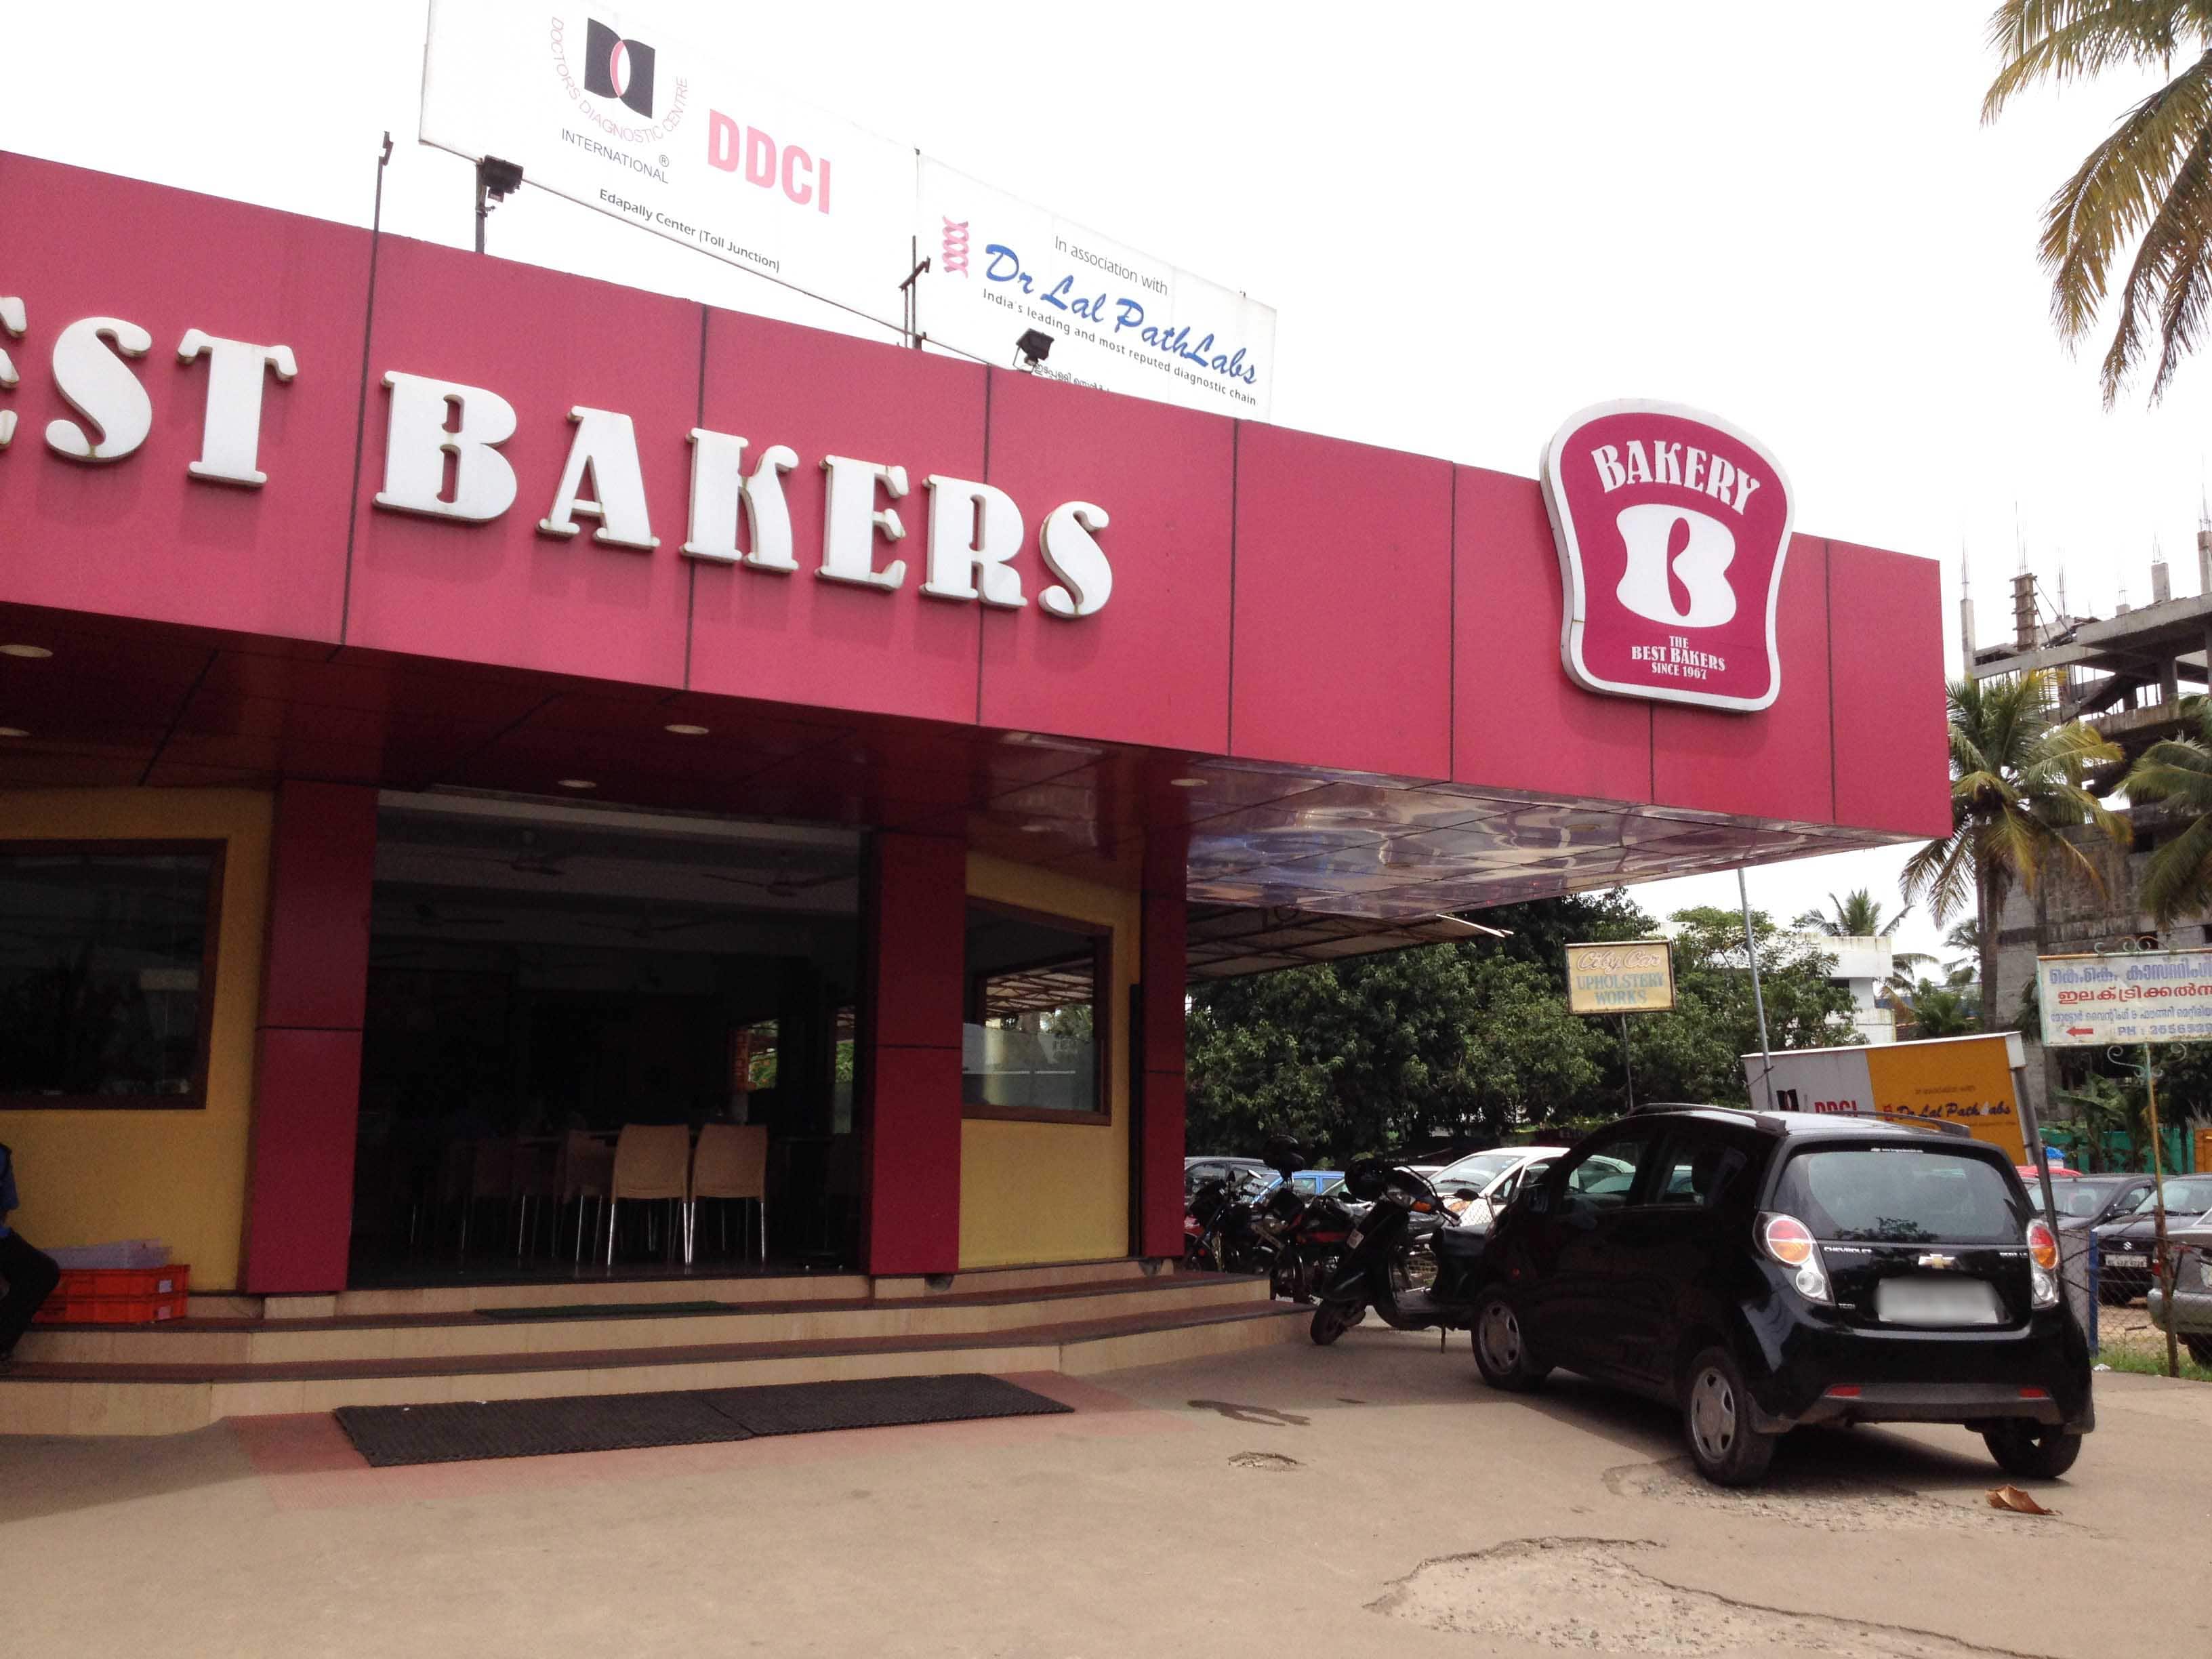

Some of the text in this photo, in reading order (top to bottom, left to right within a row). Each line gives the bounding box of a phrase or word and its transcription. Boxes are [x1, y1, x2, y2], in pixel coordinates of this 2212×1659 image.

[550, 16, 689, 143] DOCTORS DIAGNOSTIC CENTRE
[562, 128, 669, 184] INTERNATIONAL
[708, 108, 830, 215] DDCI
[600, 188, 780, 273] Edapally Center (Toll Junction)
[1055, 235, 1168, 295] In association with
[985, 244, 1034, 294] Dr
[1040, 274, 1104, 323] Lal
[983, 289, 1256, 405] India's leading and most reputed diagnostic chain
[0, 296, 1113, 619] ST BAKERS
[1591, 440, 1760, 515] BAKERY
[1631, 646, 1725, 671] BEST BAKERS
[1652, 662, 1708, 680] SINCE 1967
[1669, 636, 1689, 649] THE
[1595, 989, 1647, 1005] WORKS
